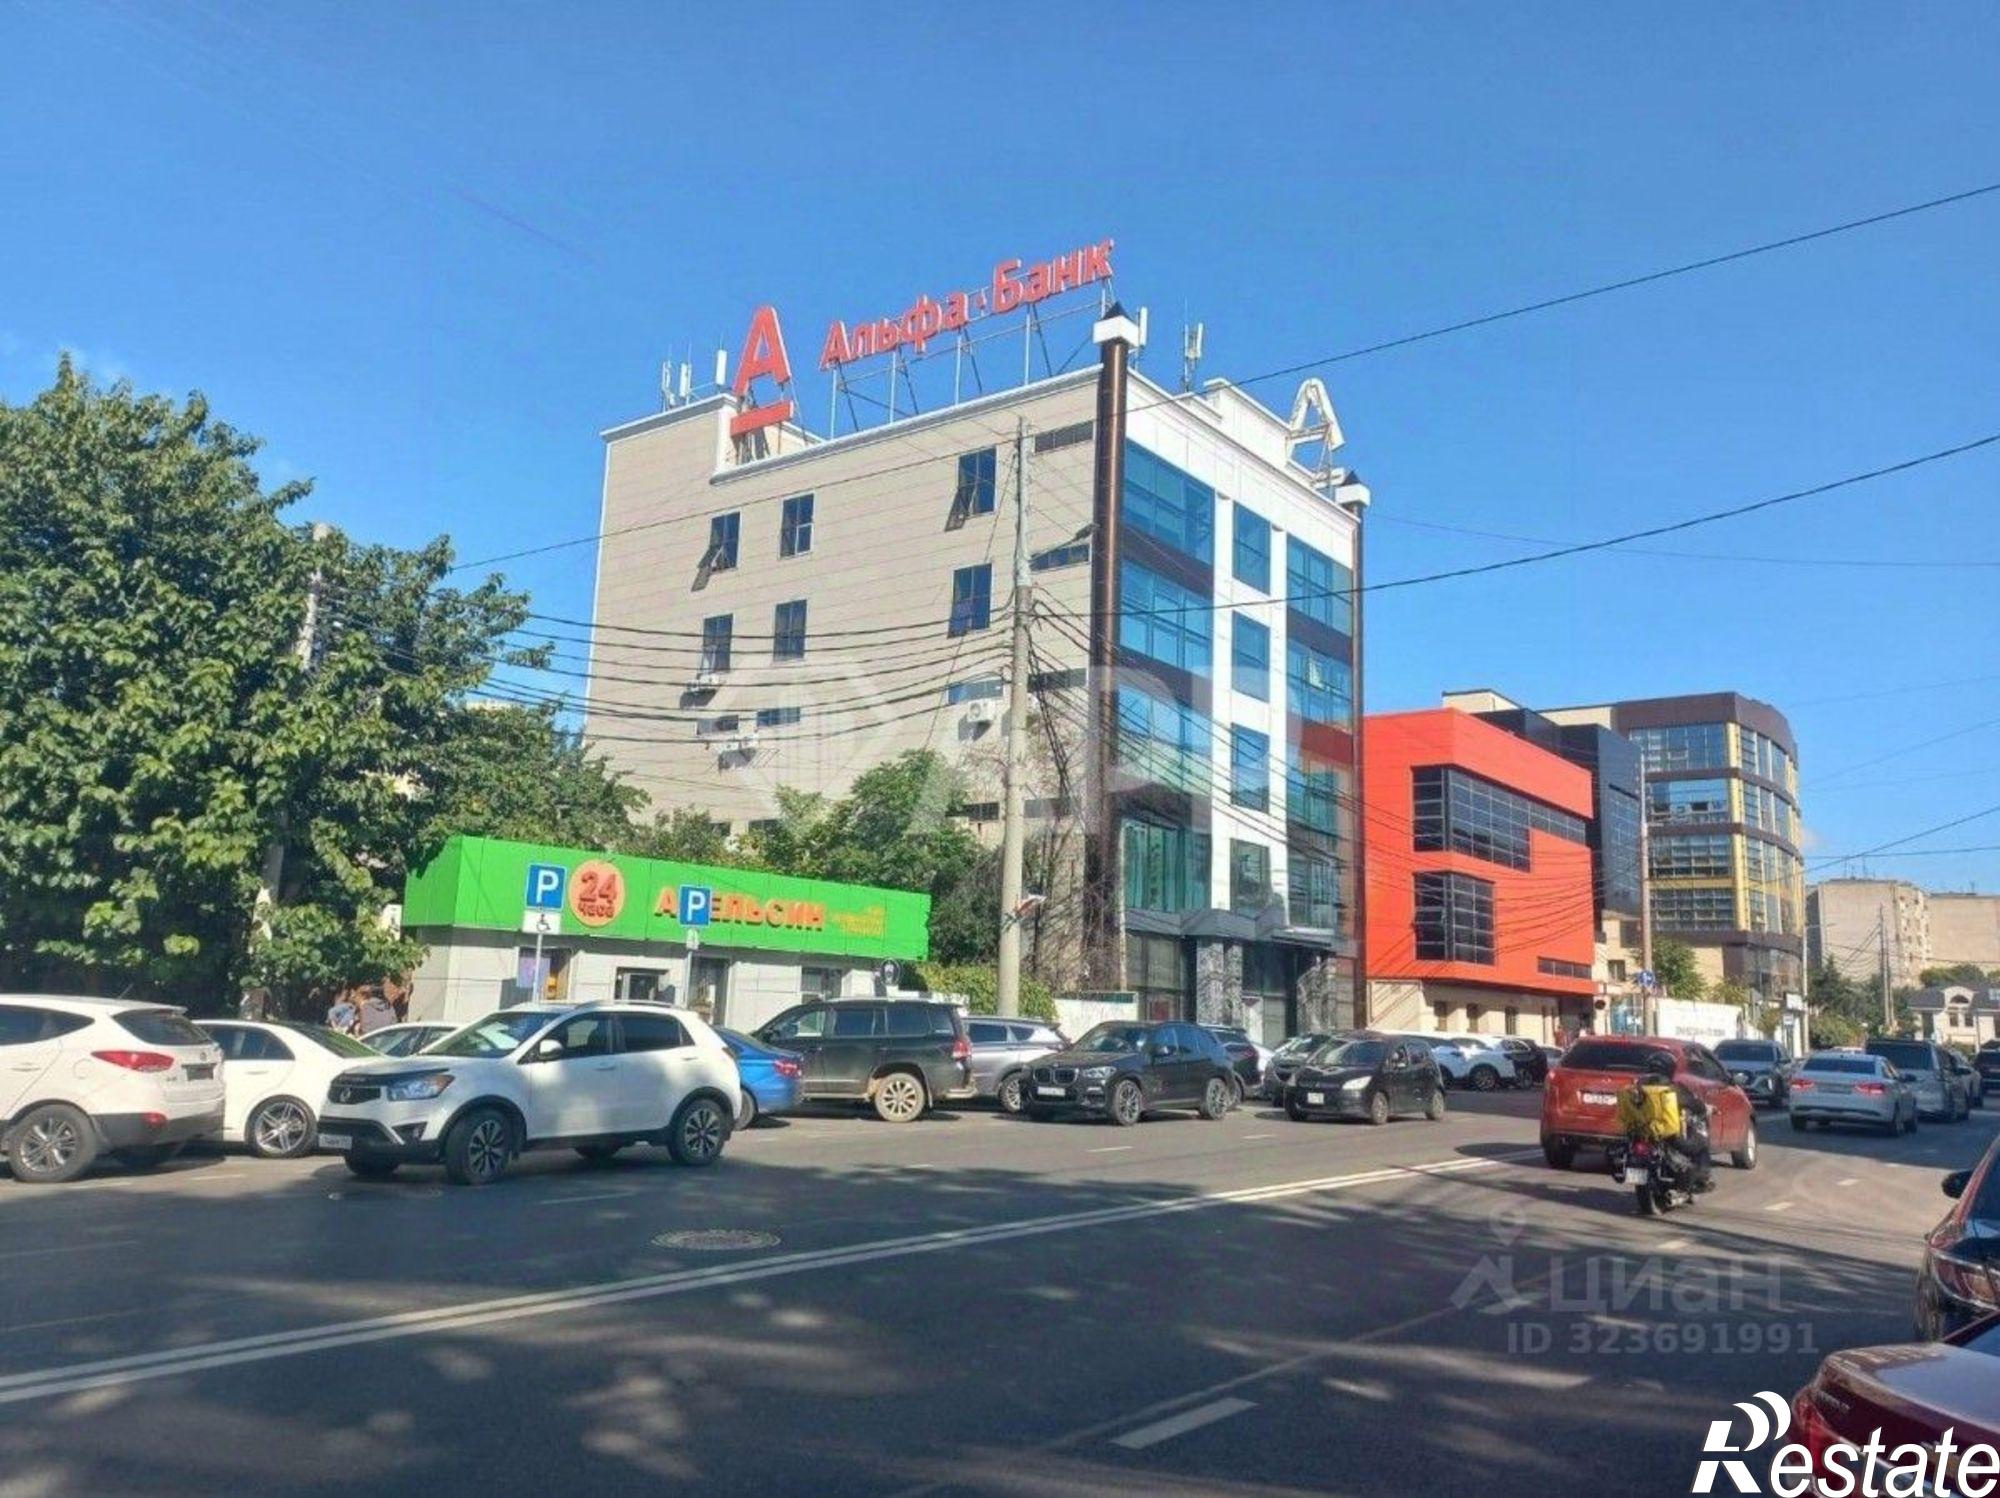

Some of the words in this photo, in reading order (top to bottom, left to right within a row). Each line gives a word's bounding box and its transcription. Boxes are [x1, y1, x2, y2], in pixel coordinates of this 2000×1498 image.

[536, 869, 559, 903] P
[579, 870, 618, 904] 24
[686, 890, 705, 922] P
